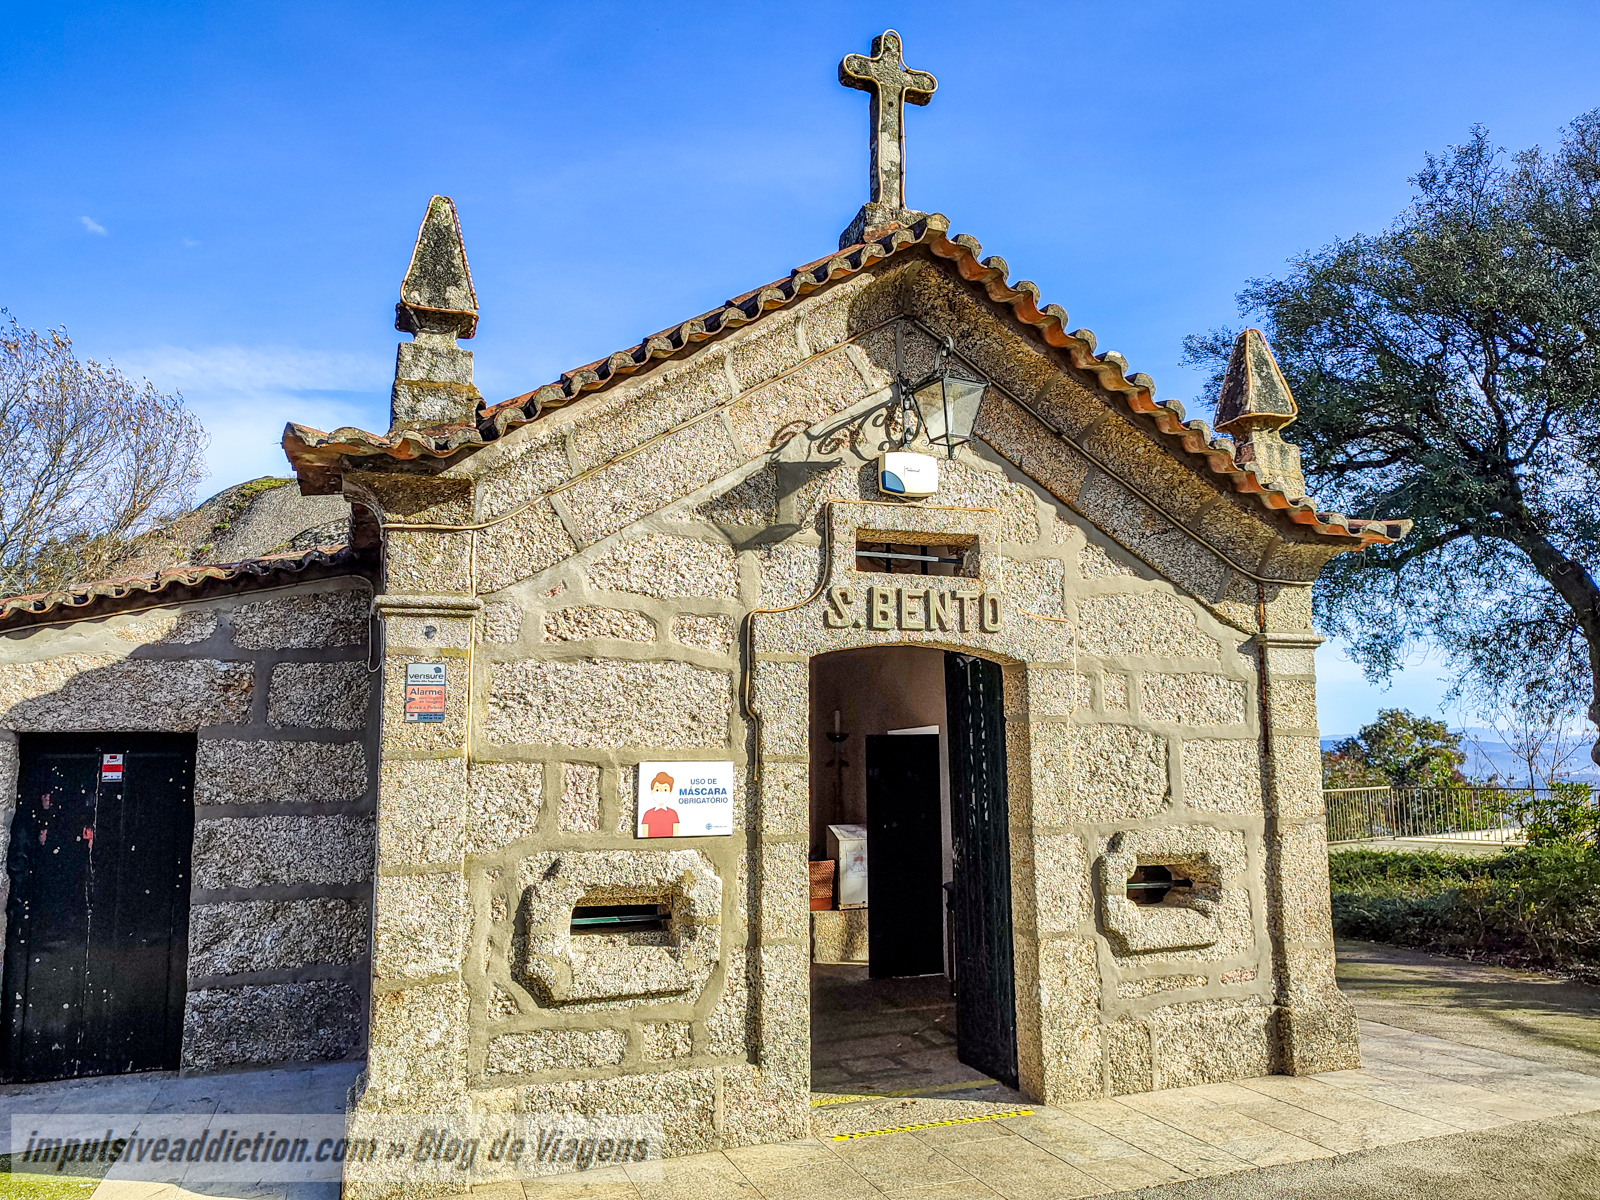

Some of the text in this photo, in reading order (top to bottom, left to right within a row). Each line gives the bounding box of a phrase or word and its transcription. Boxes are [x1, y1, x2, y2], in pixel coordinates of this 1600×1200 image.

[409, 687, 443, 696] Alarme
[679, 786, 727, 795] MÁSCARA
[678, 796, 728, 804] OBRIGATÓRIO
